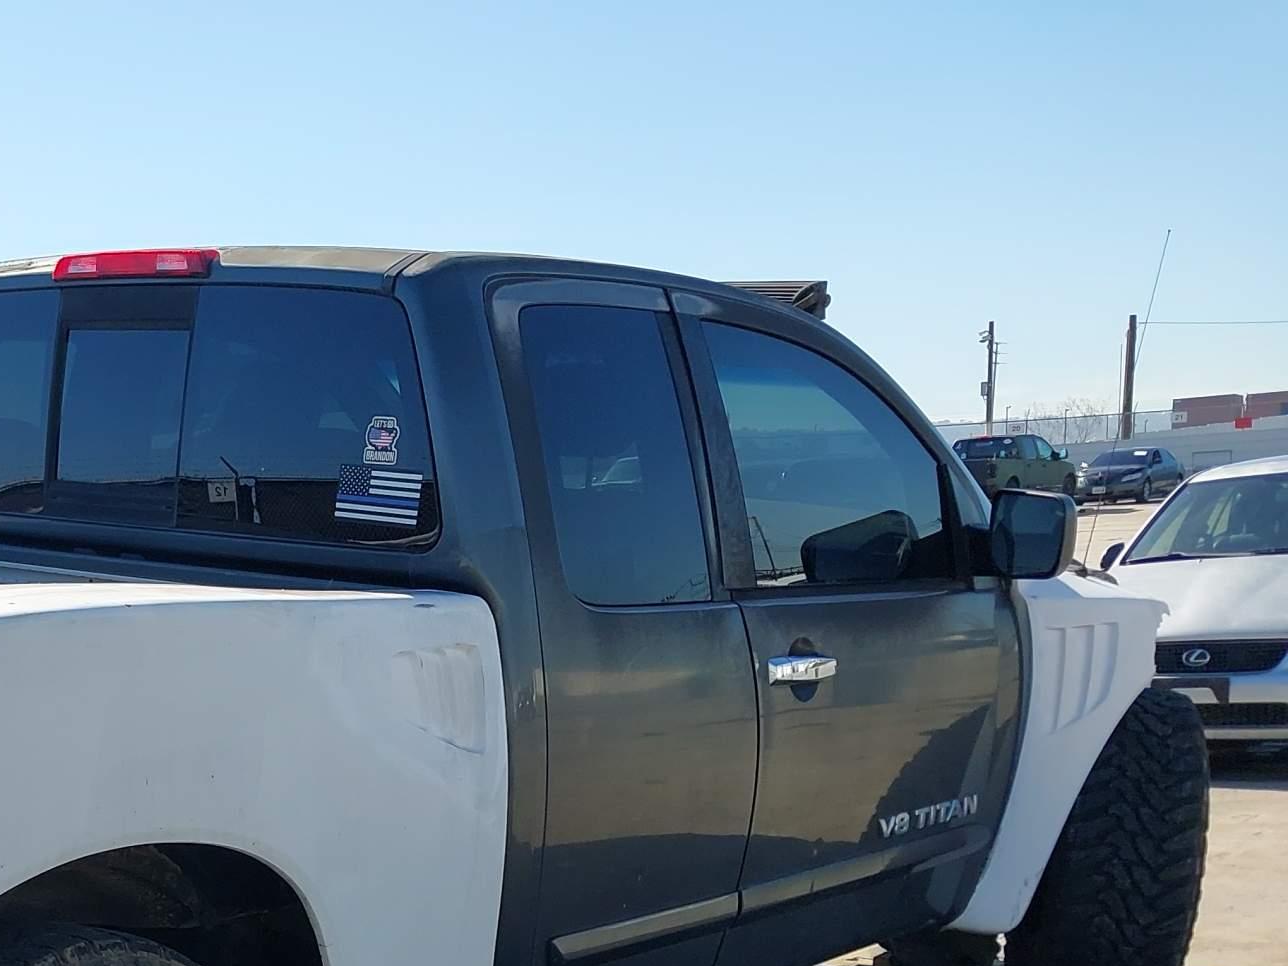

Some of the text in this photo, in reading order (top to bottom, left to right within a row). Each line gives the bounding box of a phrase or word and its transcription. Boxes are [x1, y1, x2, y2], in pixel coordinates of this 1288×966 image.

[373, 419, 395, 429] LET'S GO
[365, 450, 395, 462] BRANDON
[878, 793, 979, 839] V8 TITAN
